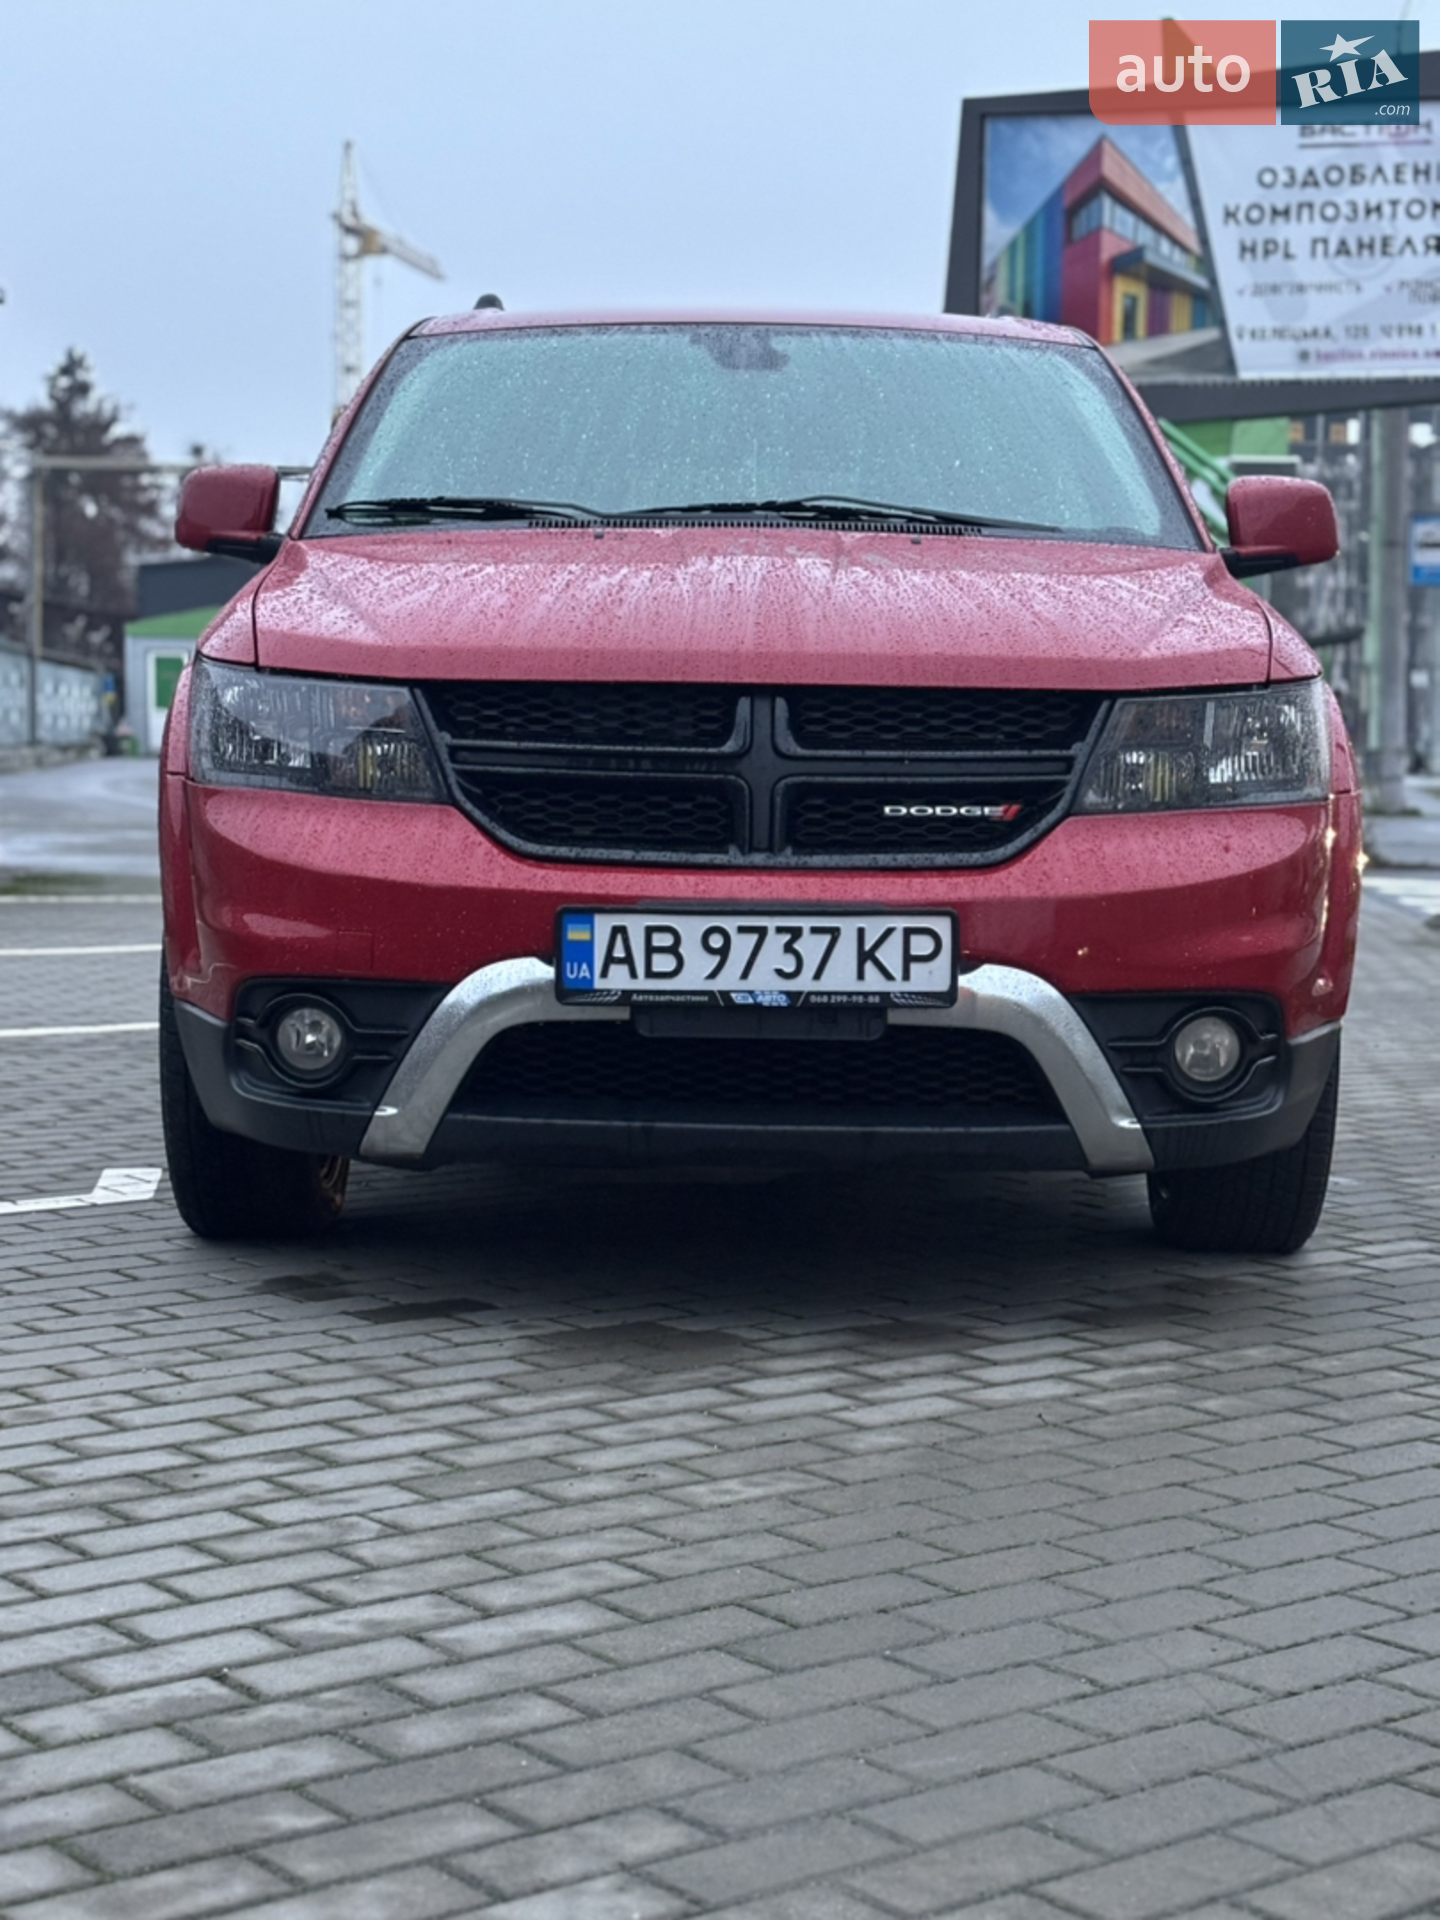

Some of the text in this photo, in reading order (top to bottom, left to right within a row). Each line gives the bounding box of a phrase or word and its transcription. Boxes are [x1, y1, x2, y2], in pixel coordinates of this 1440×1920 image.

[1257, 162, 1440, 189] ОЗДОБЛЕН
[1239, 238, 1297, 262] HPL
[883, 804, 1004, 817] DODGE
[600, 924, 943, 982] AB 9737 KP
[566, 961, 591, 980] UA
